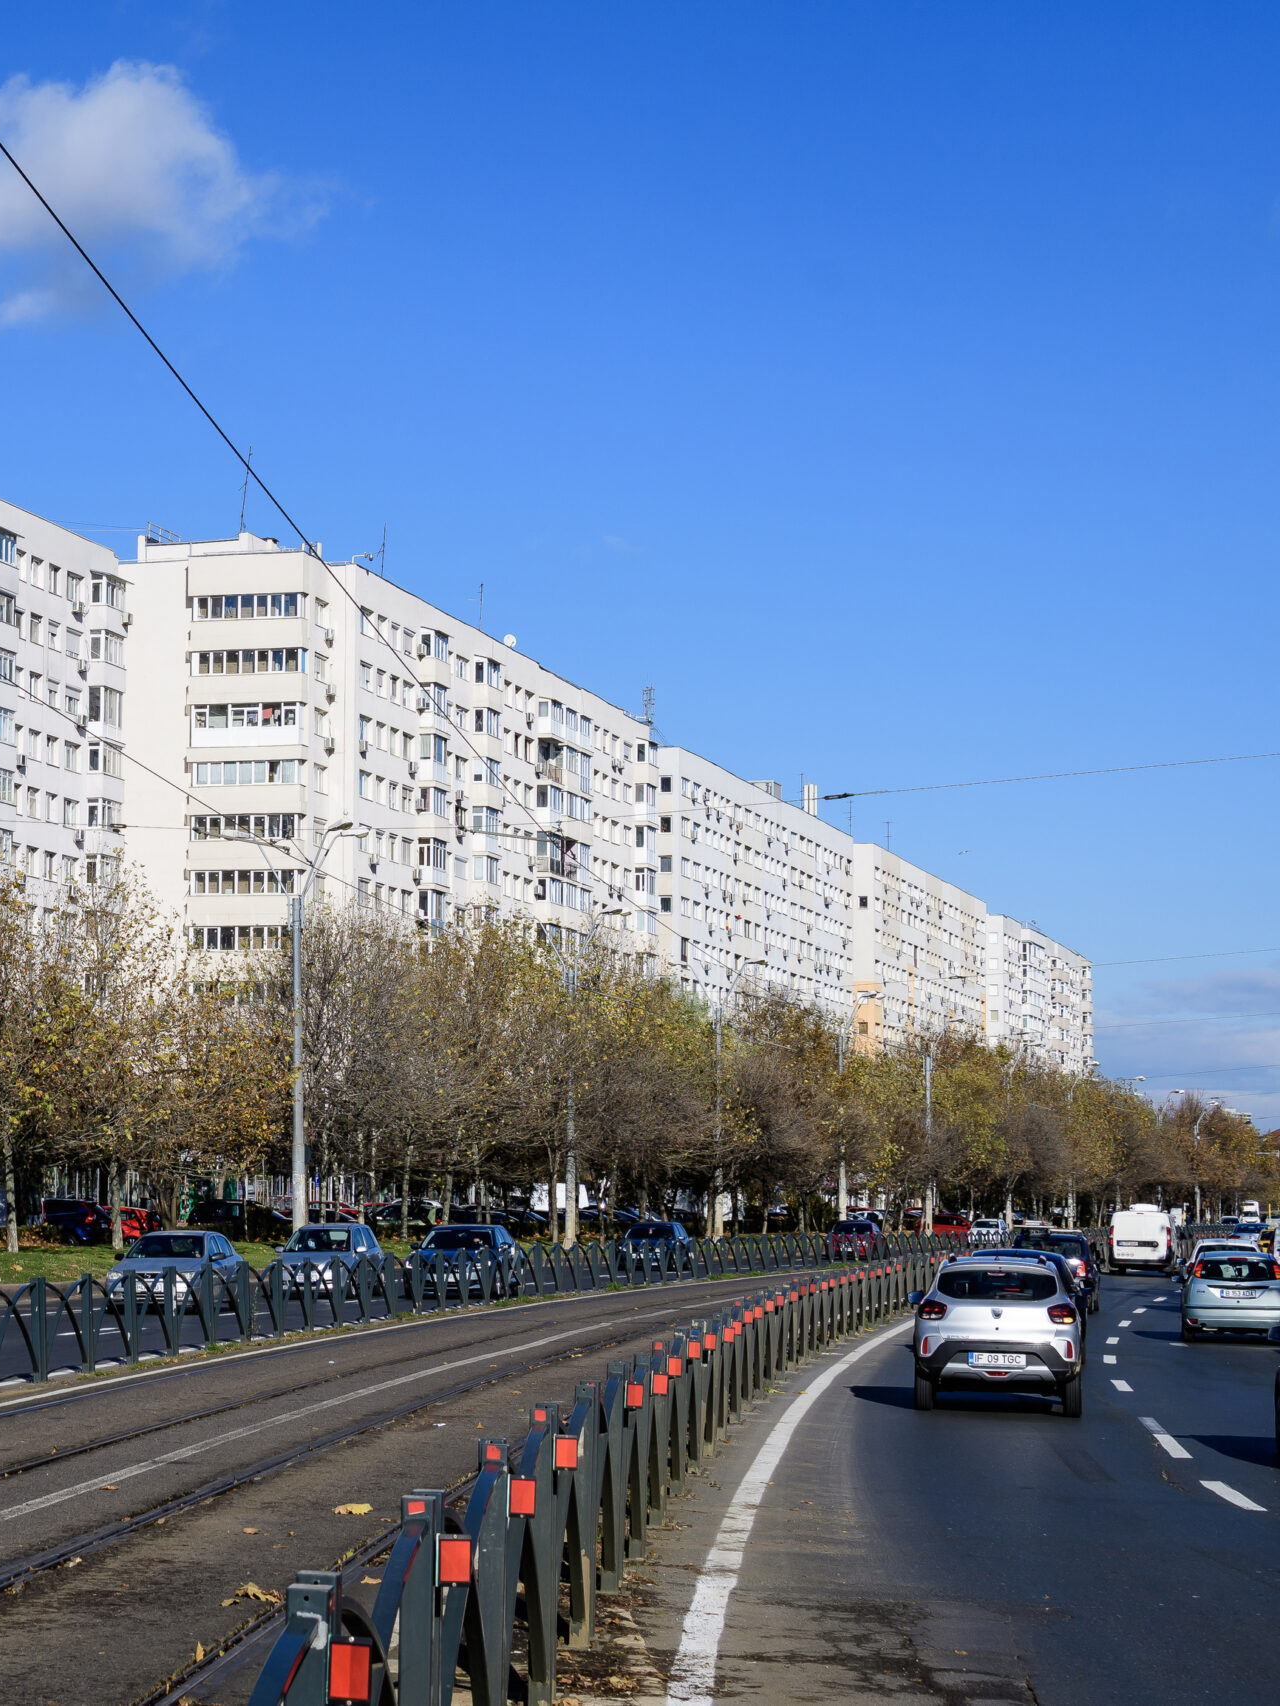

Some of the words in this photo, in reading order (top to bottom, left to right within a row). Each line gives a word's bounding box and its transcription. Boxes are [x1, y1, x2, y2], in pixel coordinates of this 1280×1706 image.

[974, 1353, 984, 1363] IF
[987, 1354, 999, 1363] 09
[1002, 1354, 1022, 1364] TGC
